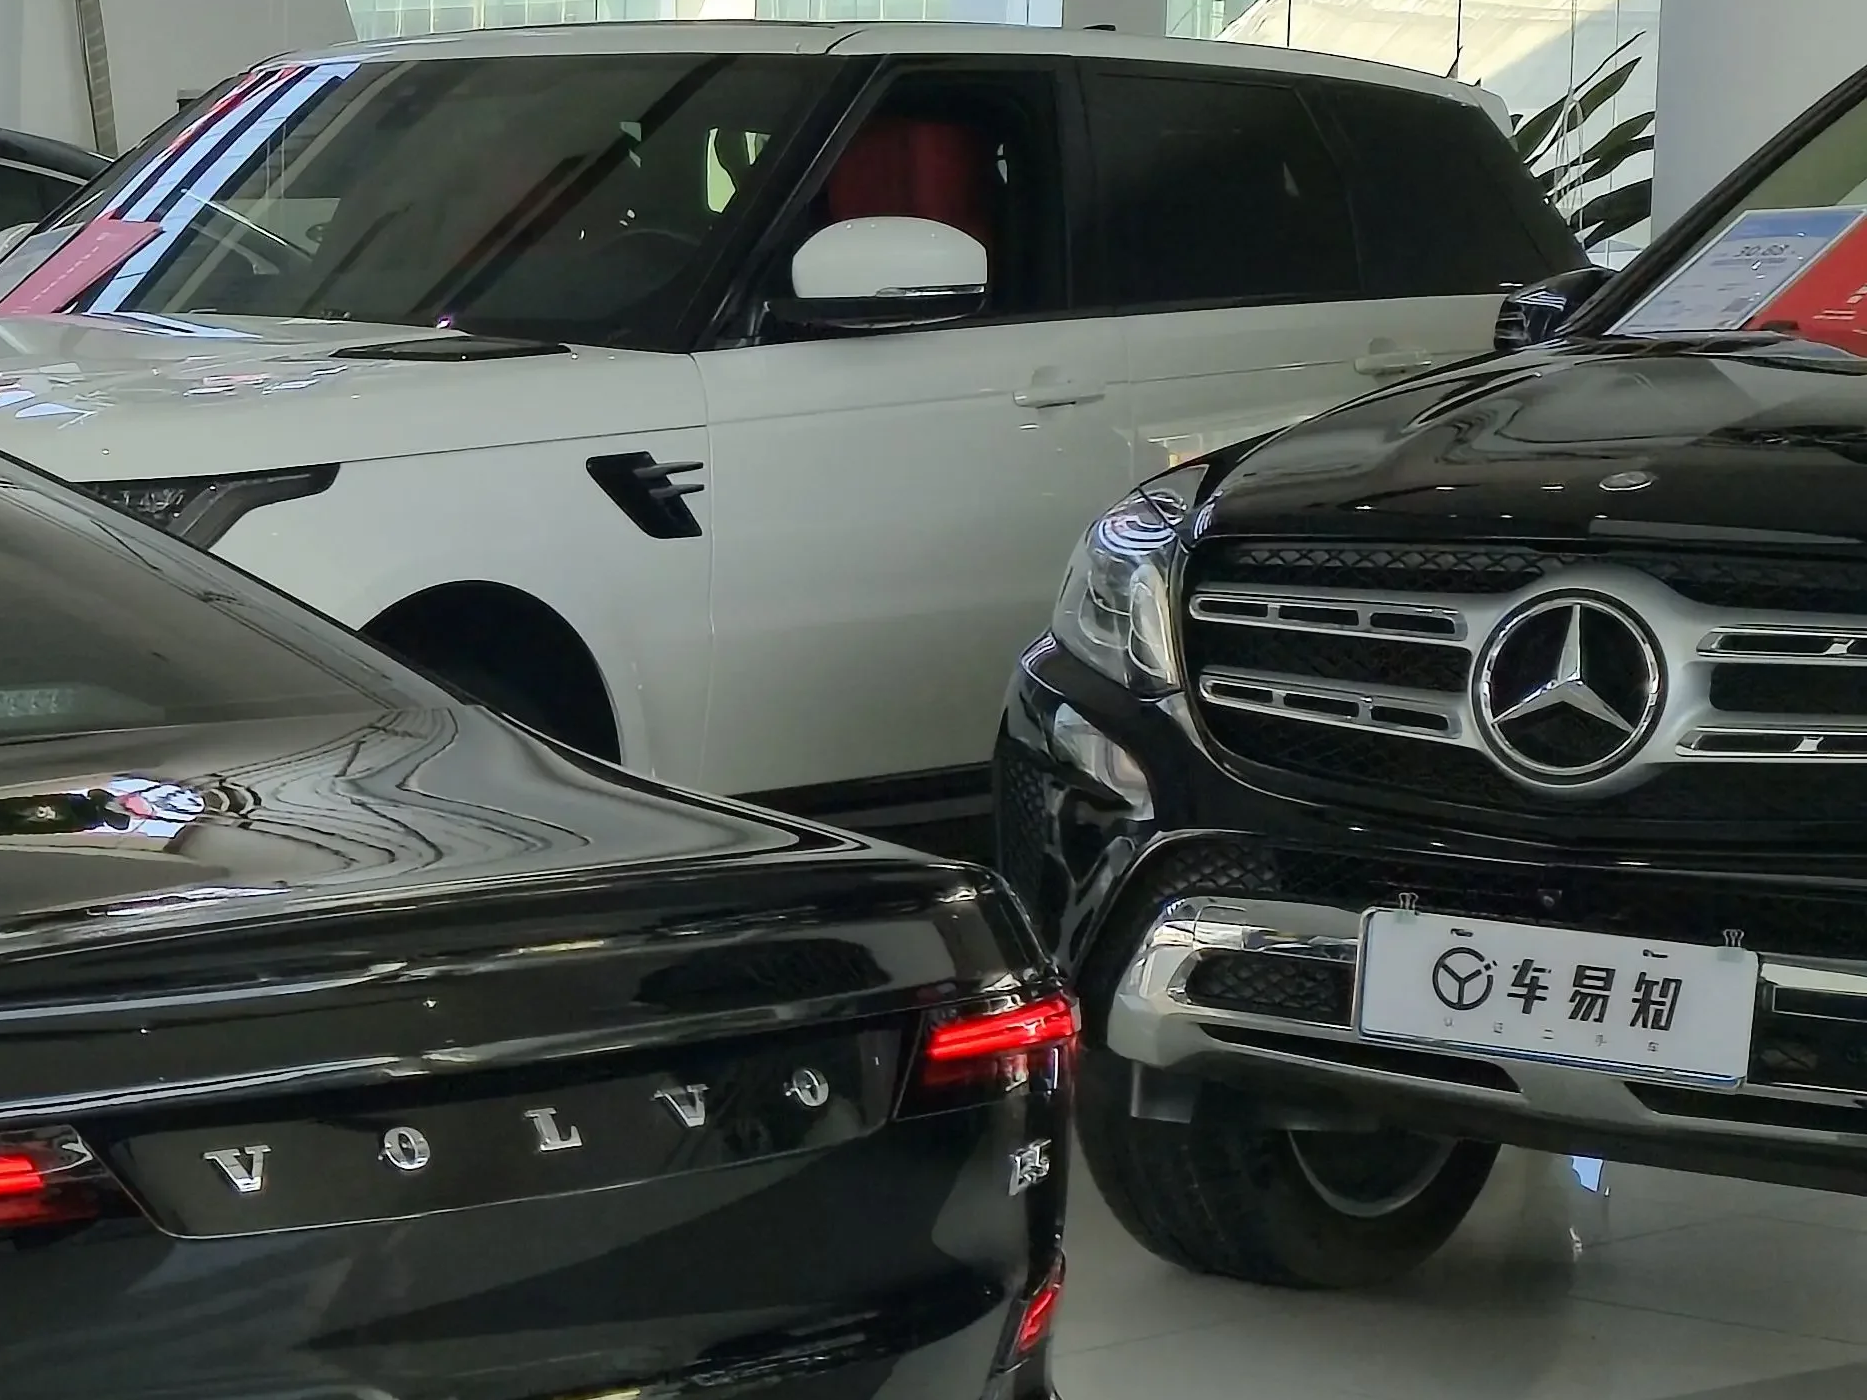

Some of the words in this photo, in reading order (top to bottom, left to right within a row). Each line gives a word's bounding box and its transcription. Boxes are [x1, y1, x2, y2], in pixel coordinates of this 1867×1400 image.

[1507, 958, 1683, 1032] 车易知
[203, 1067, 830, 1194] VOLVO
